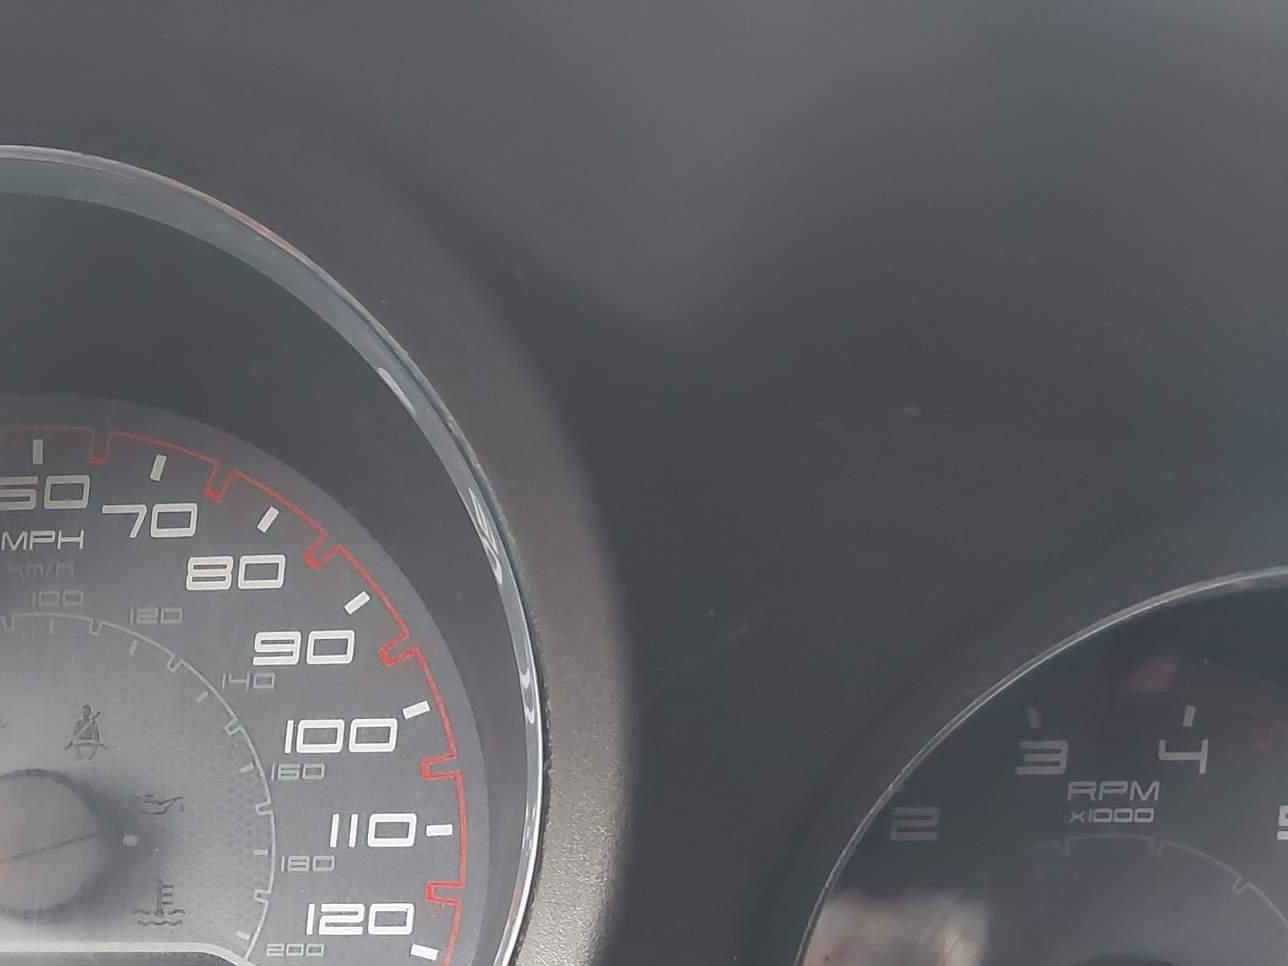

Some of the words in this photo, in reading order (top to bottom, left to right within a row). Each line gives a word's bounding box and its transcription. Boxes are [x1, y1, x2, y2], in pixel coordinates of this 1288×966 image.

[101, 502, 198, 539] 70
[0, 529, 86, 552] MPH
[185, 553, 287, 591] 80
[31, 590, 85, 608] 100
[129, 607, 184, 625] 120
[252, 630, 356, 666] 90
[221, 672, 276, 690] 140
[284, 718, 398, 754] 100
[271, 763, 326, 781] 160
[1016, 740, 1069, 776] 3
[1158, 739, 1209, 775] 4
[1066, 780, 1161, 802] RPM
[329, 813, 418, 848] 110
[889, 806, 941, 841] 2
[280, 855, 336, 872] 180
[306, 902, 416, 937] 120
[266, 943, 325, 957] 200
